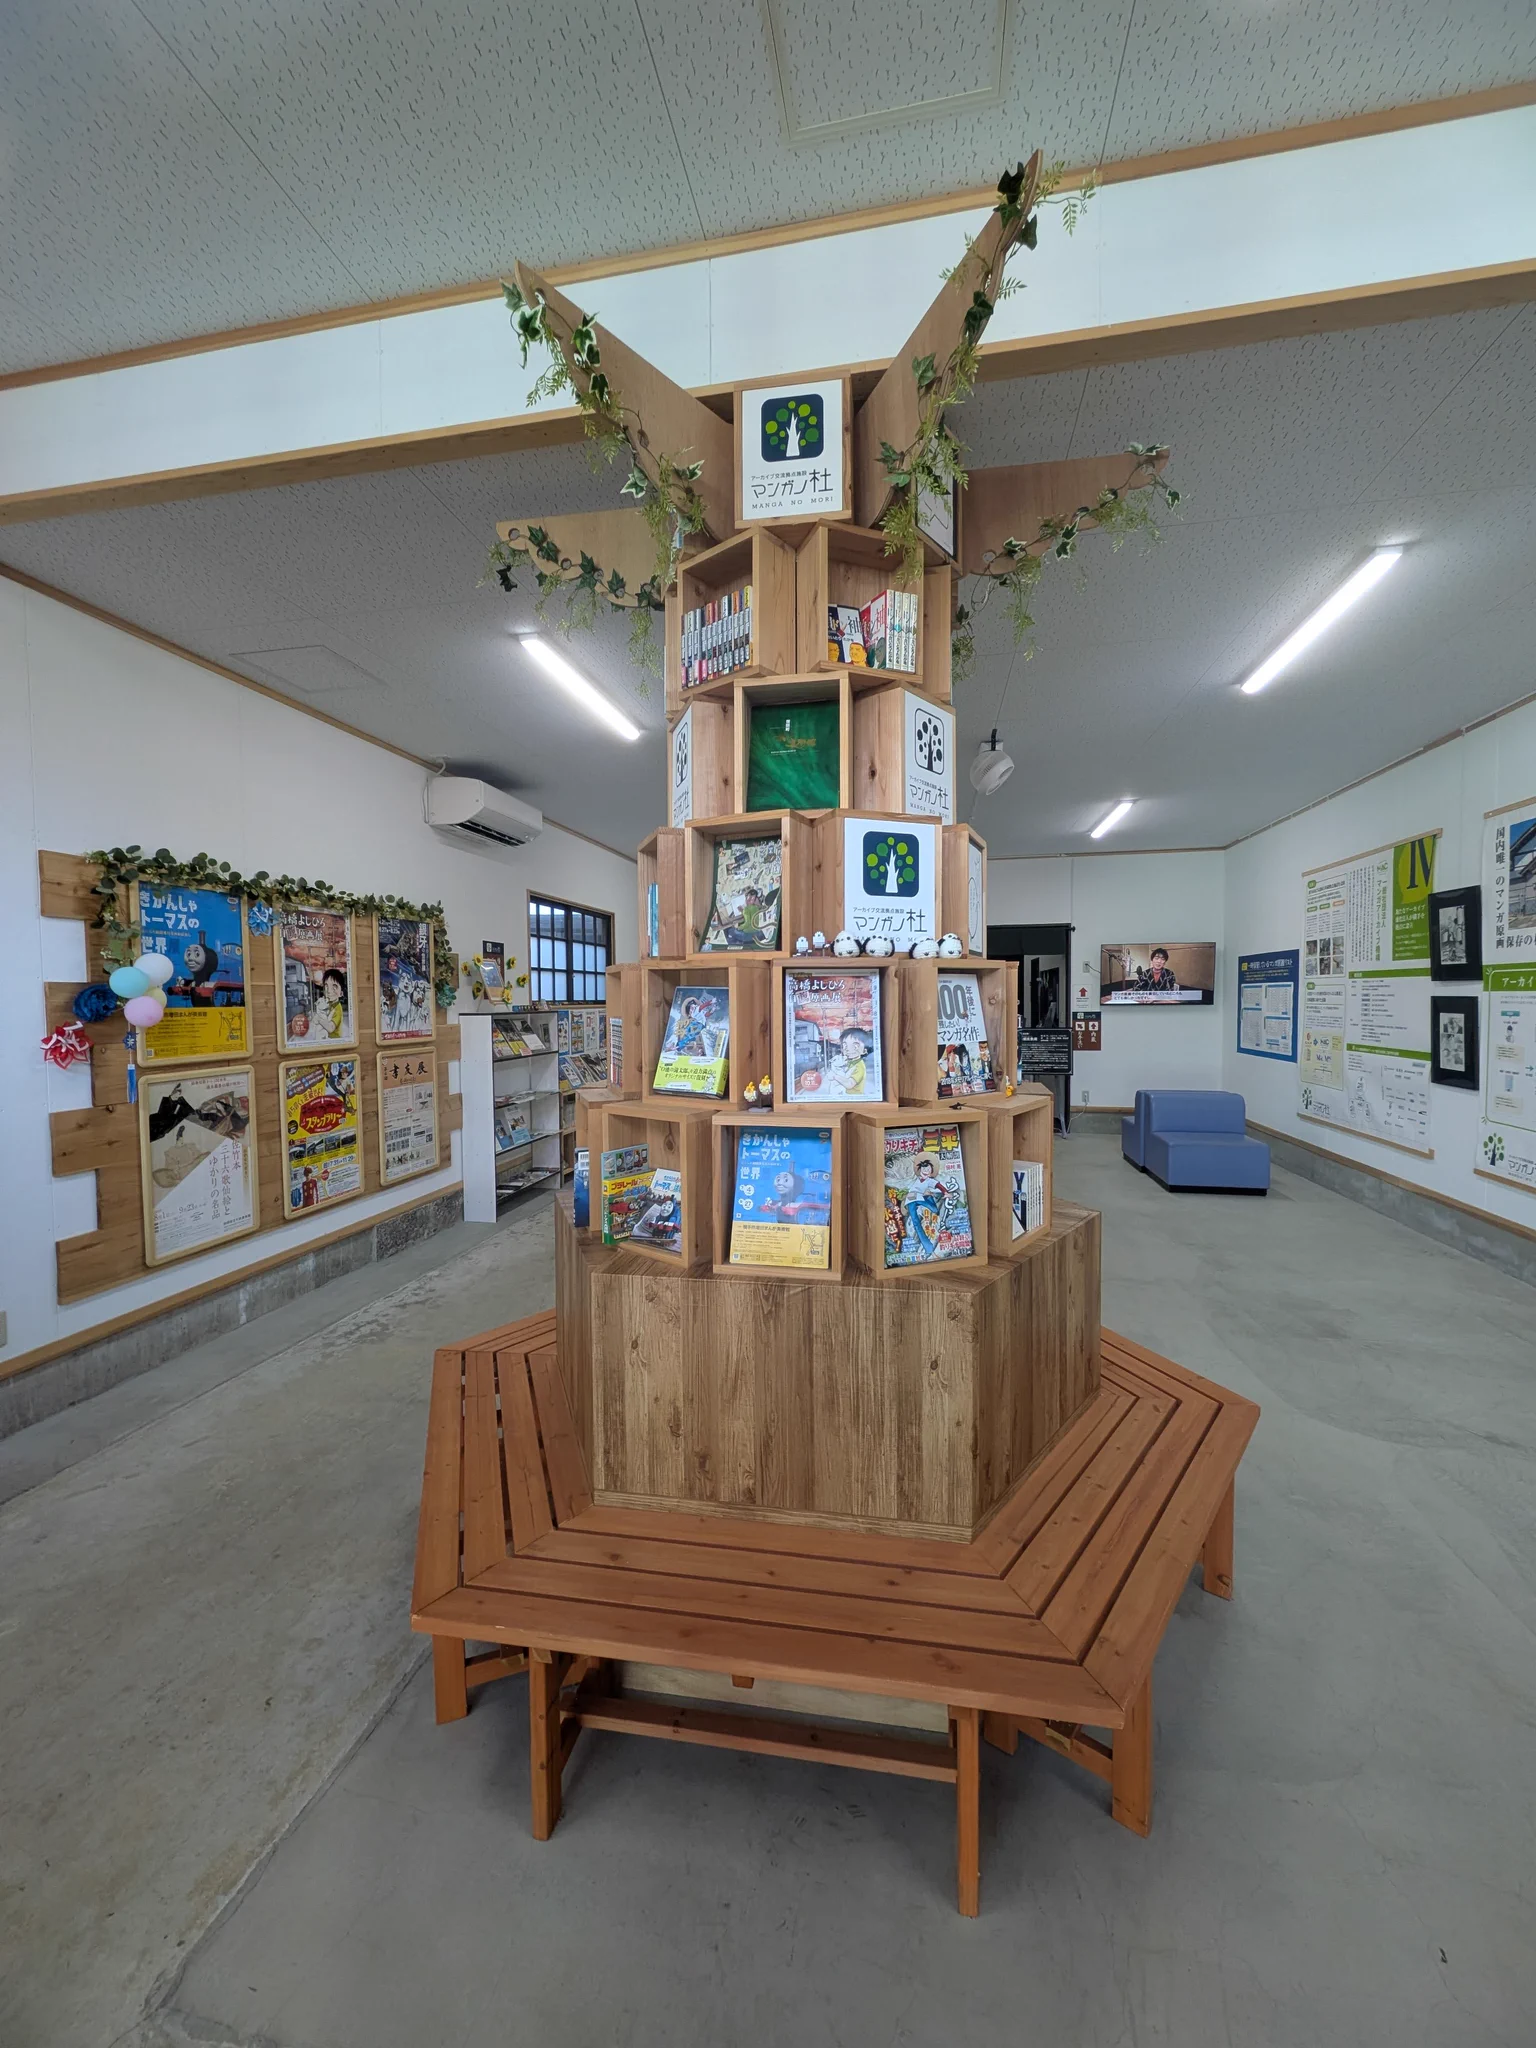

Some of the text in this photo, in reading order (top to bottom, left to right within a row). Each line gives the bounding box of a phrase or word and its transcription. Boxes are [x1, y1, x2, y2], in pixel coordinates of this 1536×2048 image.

[751, 468, 833, 498] マンガノ杜
[752, 501, 783, 509] MANGA
[811, 496, 833, 504] MORI
[140, 890, 198, 913] きかんしゃ
[141, 909, 200, 930] トーマスの
[853, 909, 927, 932] マンガノ杜
[141, 936, 167, 953] 世界
[789, 979, 846, 990] 高橋よしひろ
[306, 1113, 342, 1130] スタンプラリー
[742, 1133, 790, 1147] きかんしゃ
[742, 1147, 790, 1161] トーマスの
[741, 1167, 760, 1179] 世界
